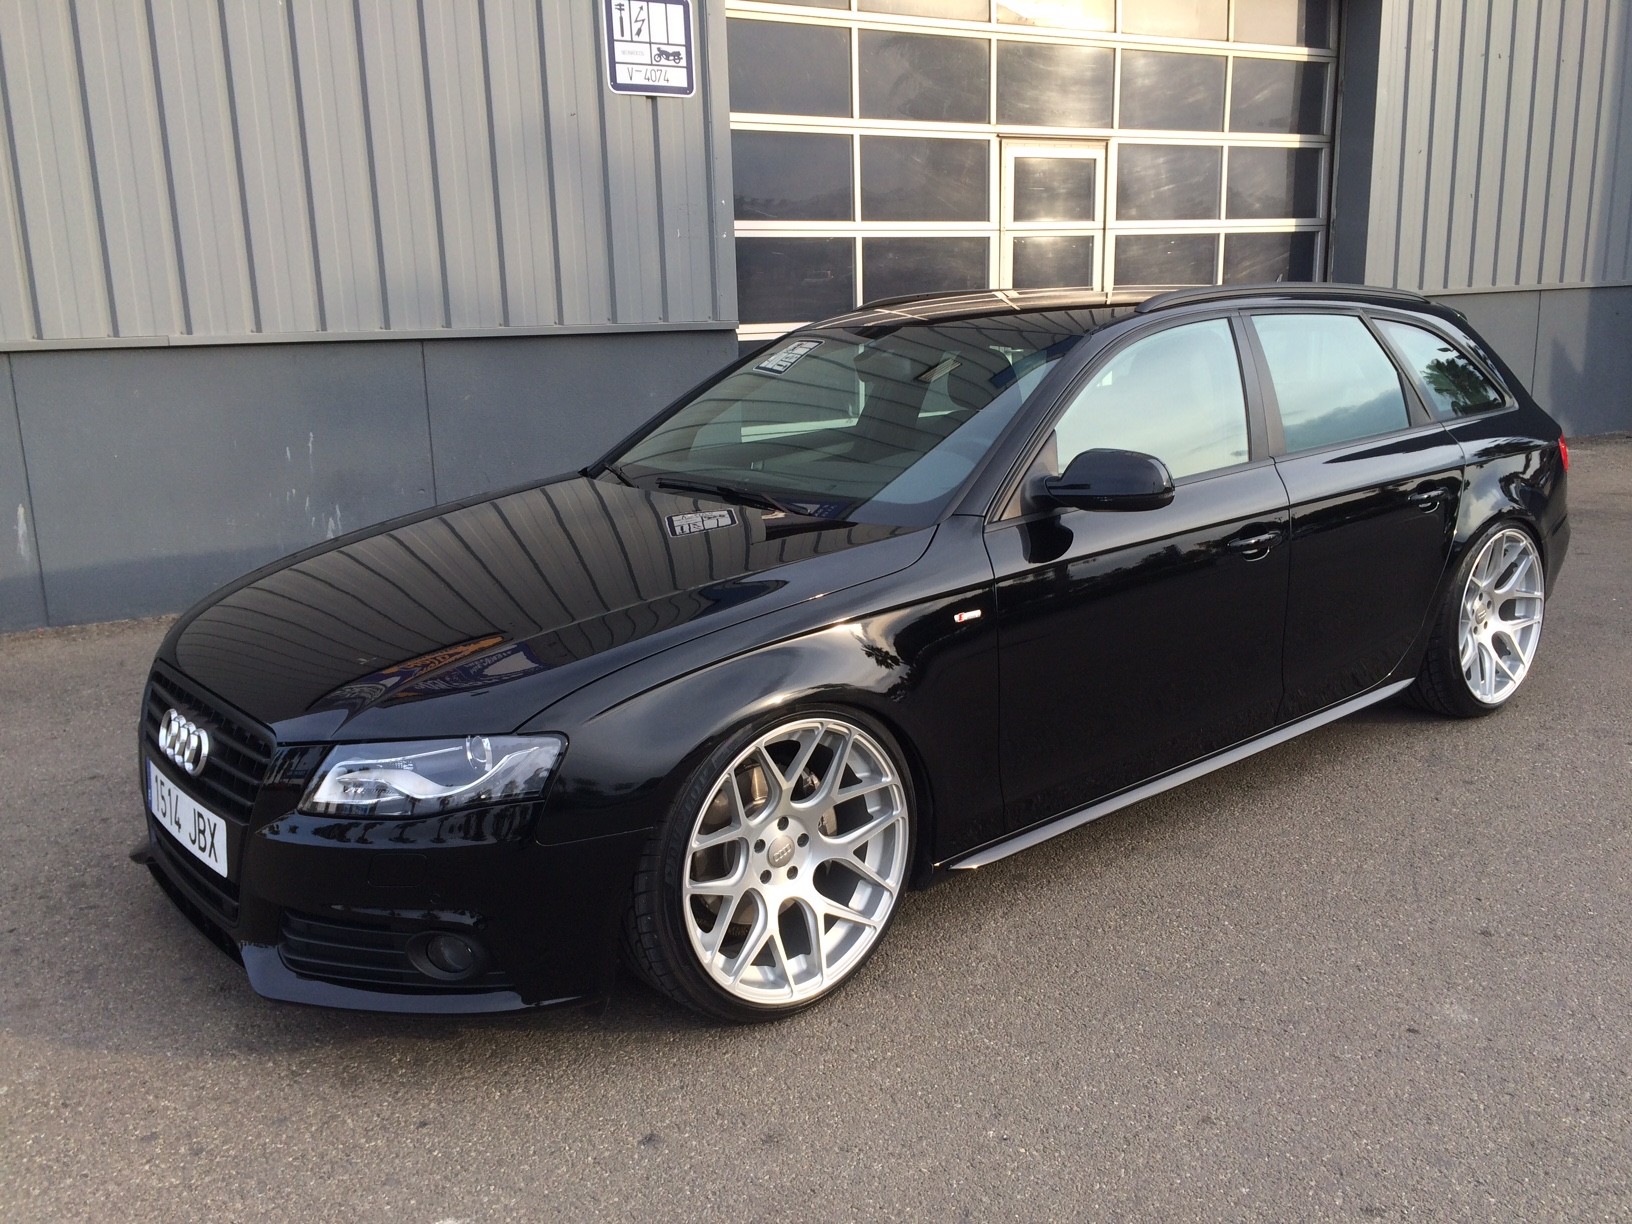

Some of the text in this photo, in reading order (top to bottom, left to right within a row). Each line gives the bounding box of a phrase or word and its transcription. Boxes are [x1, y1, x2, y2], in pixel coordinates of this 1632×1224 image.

[627, 67, 669, 83] V-4074
[155, 775, 218, 863] 1514 JBX
